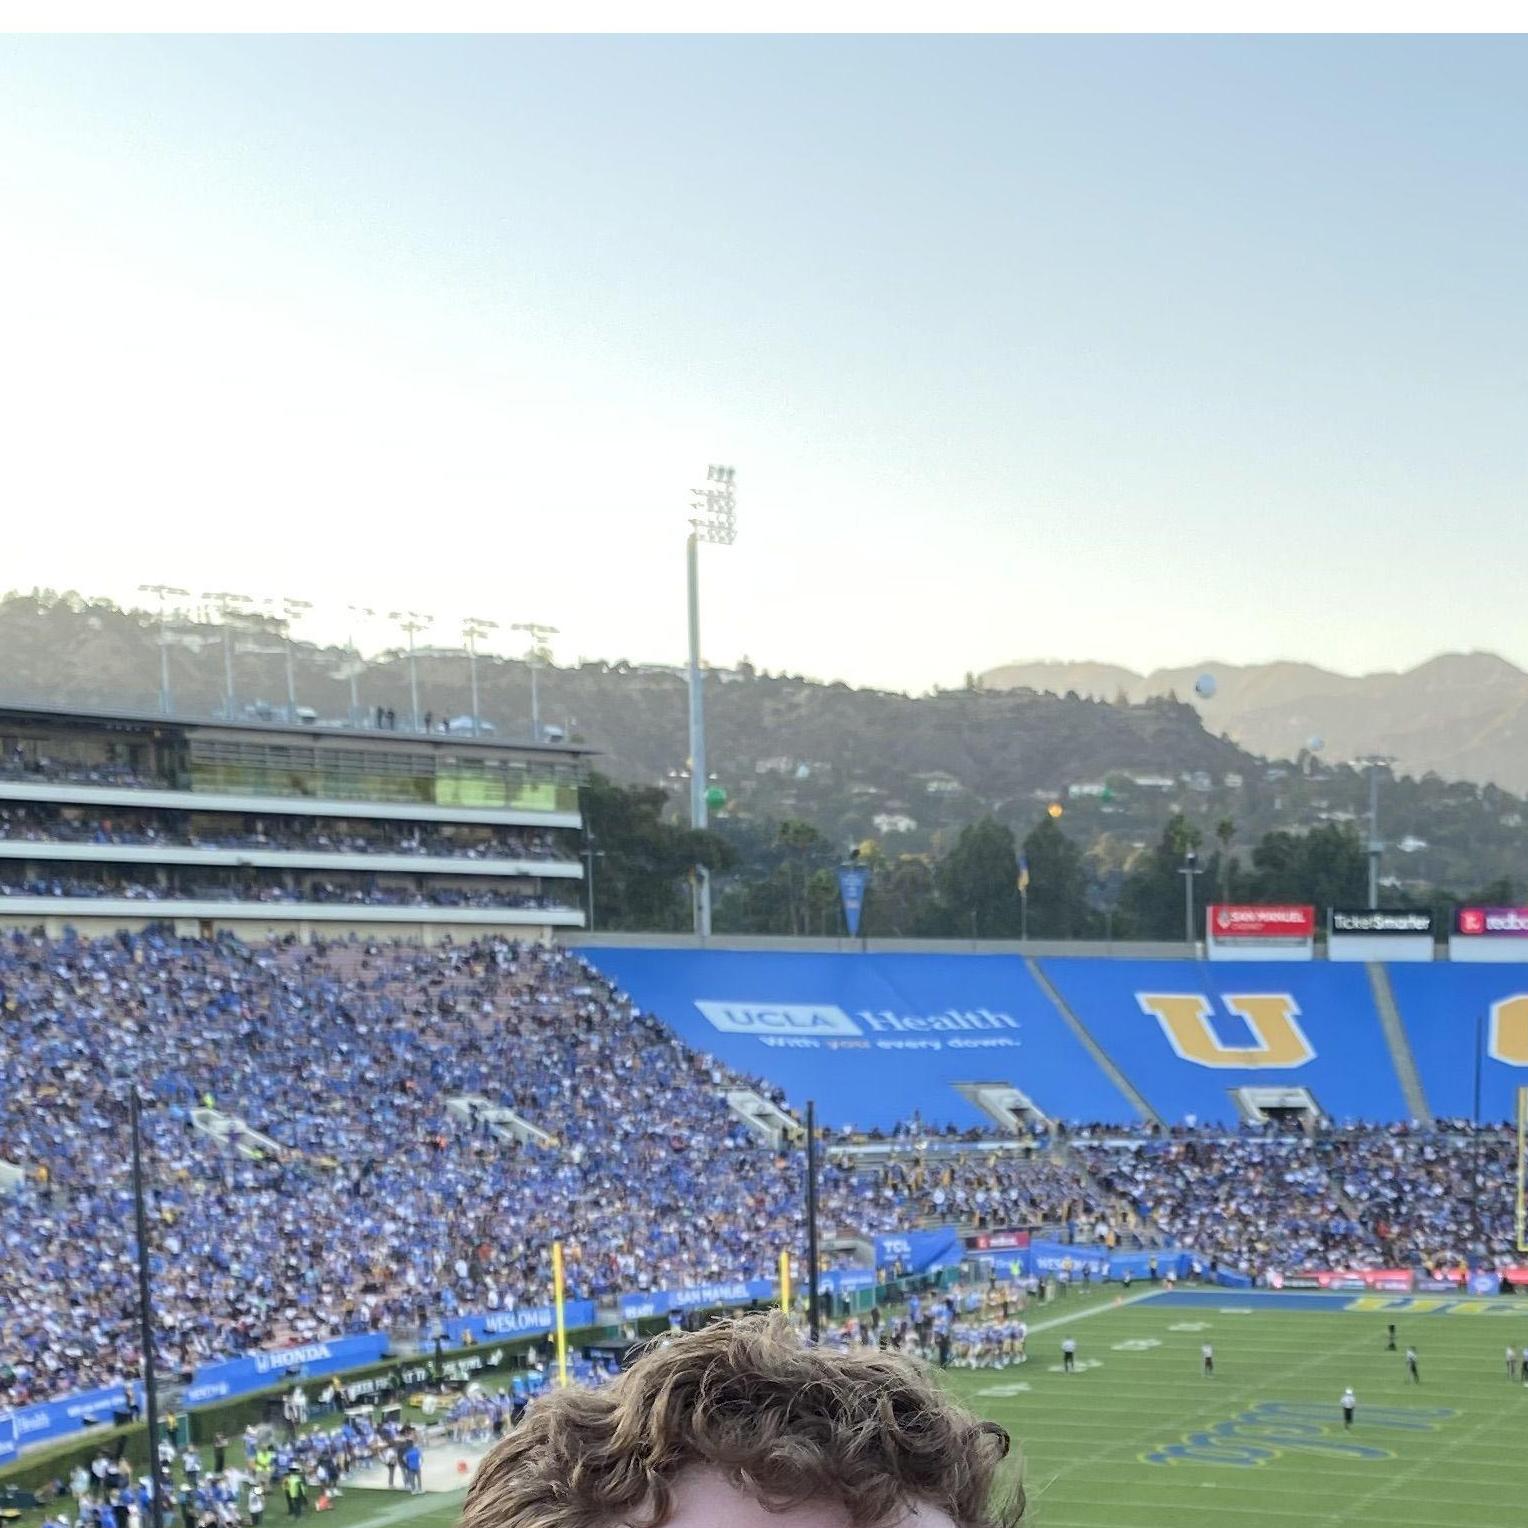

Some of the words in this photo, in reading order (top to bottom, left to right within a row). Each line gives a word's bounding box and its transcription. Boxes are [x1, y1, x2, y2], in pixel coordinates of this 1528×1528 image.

[722, 1008, 838, 1028] UCLA
[857, 1008, 1022, 1032] Health
[270, 1342, 333, 1369] HONDA
